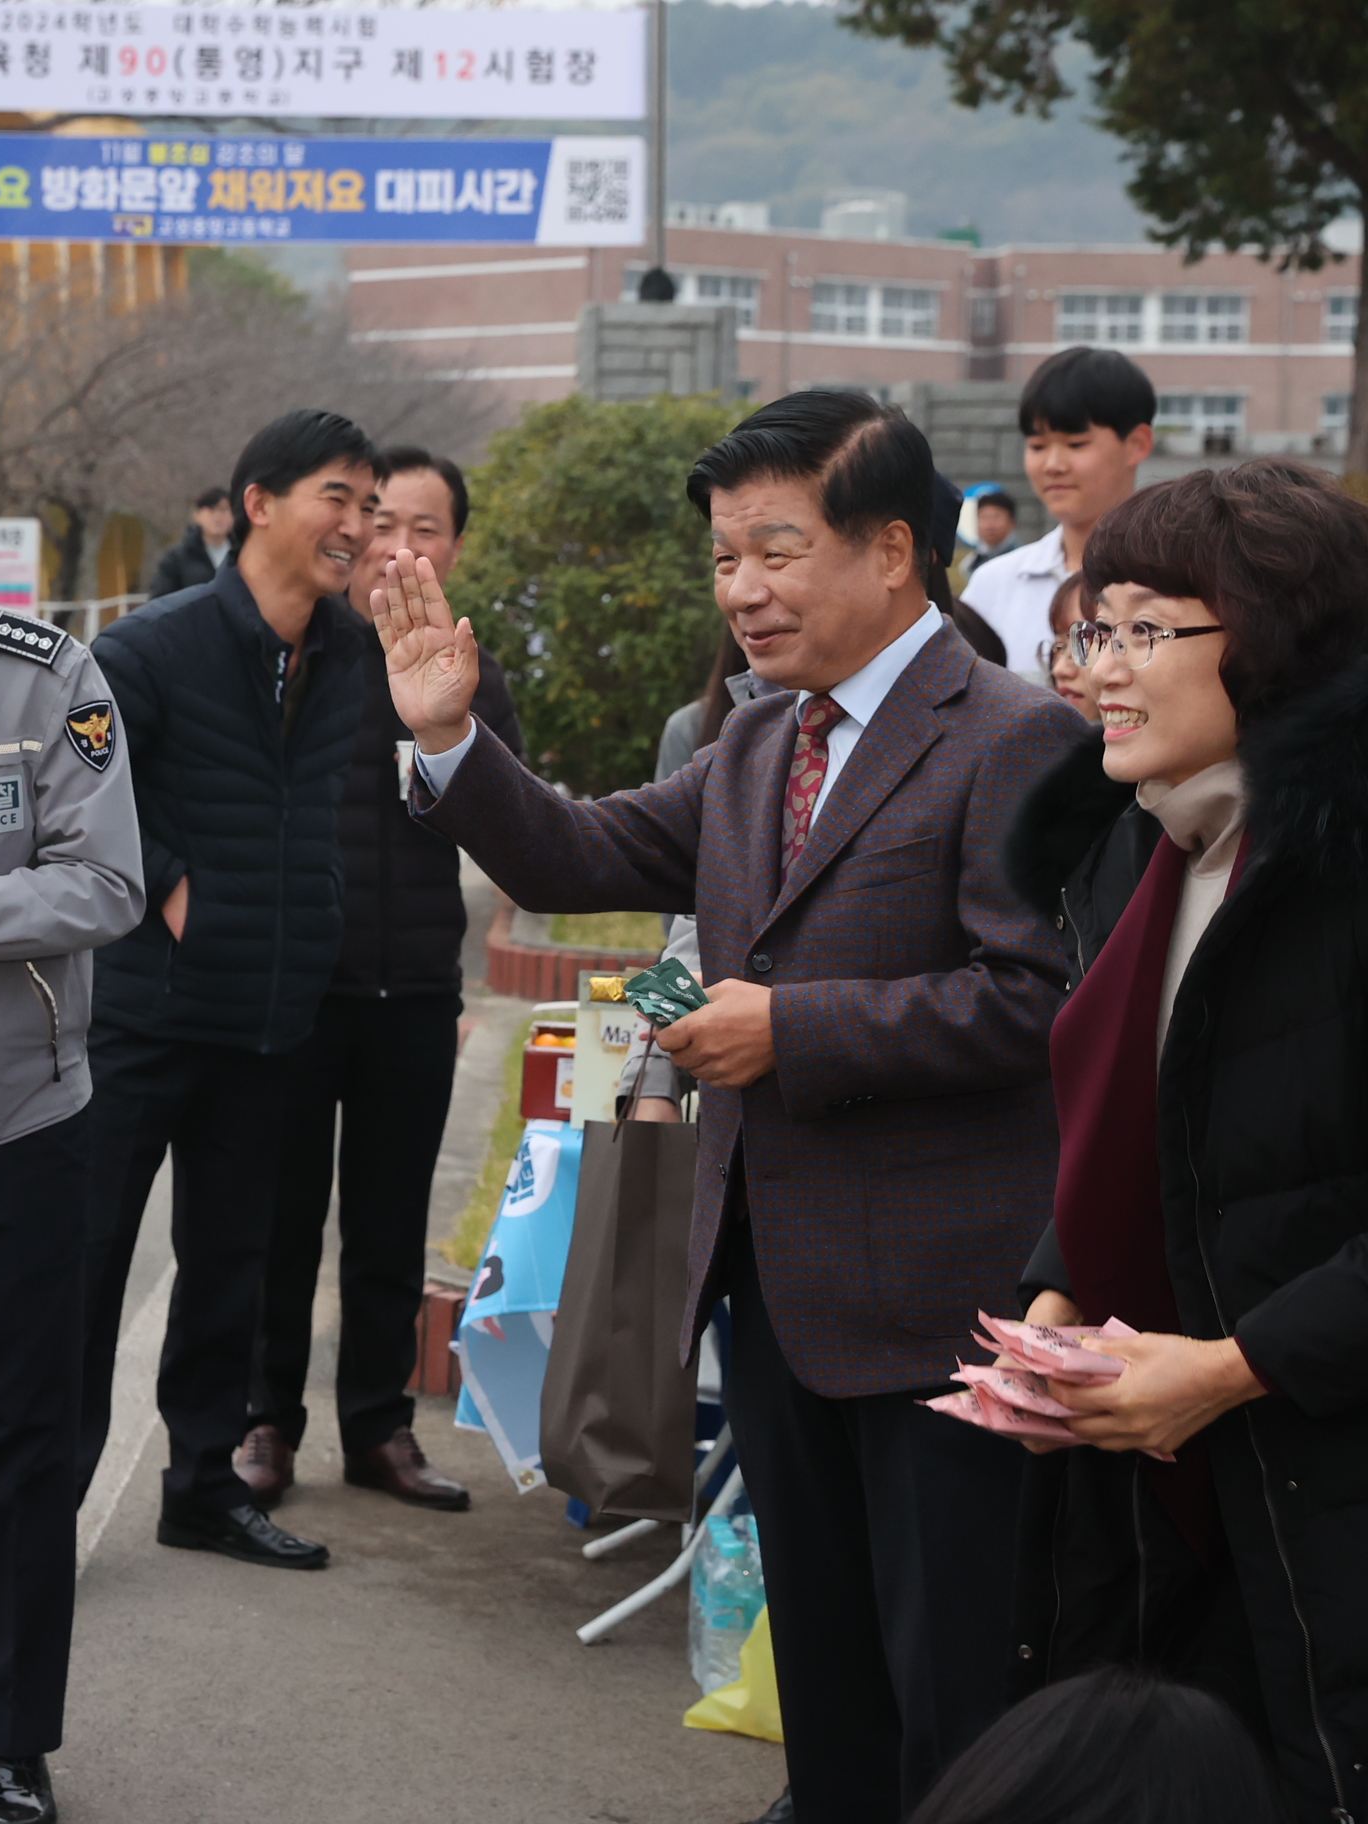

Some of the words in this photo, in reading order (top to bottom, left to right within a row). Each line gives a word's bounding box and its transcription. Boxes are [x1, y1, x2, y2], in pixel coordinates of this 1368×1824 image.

[1, 11, 144, 36] 2024학년도
[390, 47, 598, 87] 제12시험장
[375, 168, 538, 215] 대피시간
[91, 747, 109, 757] POLICE
